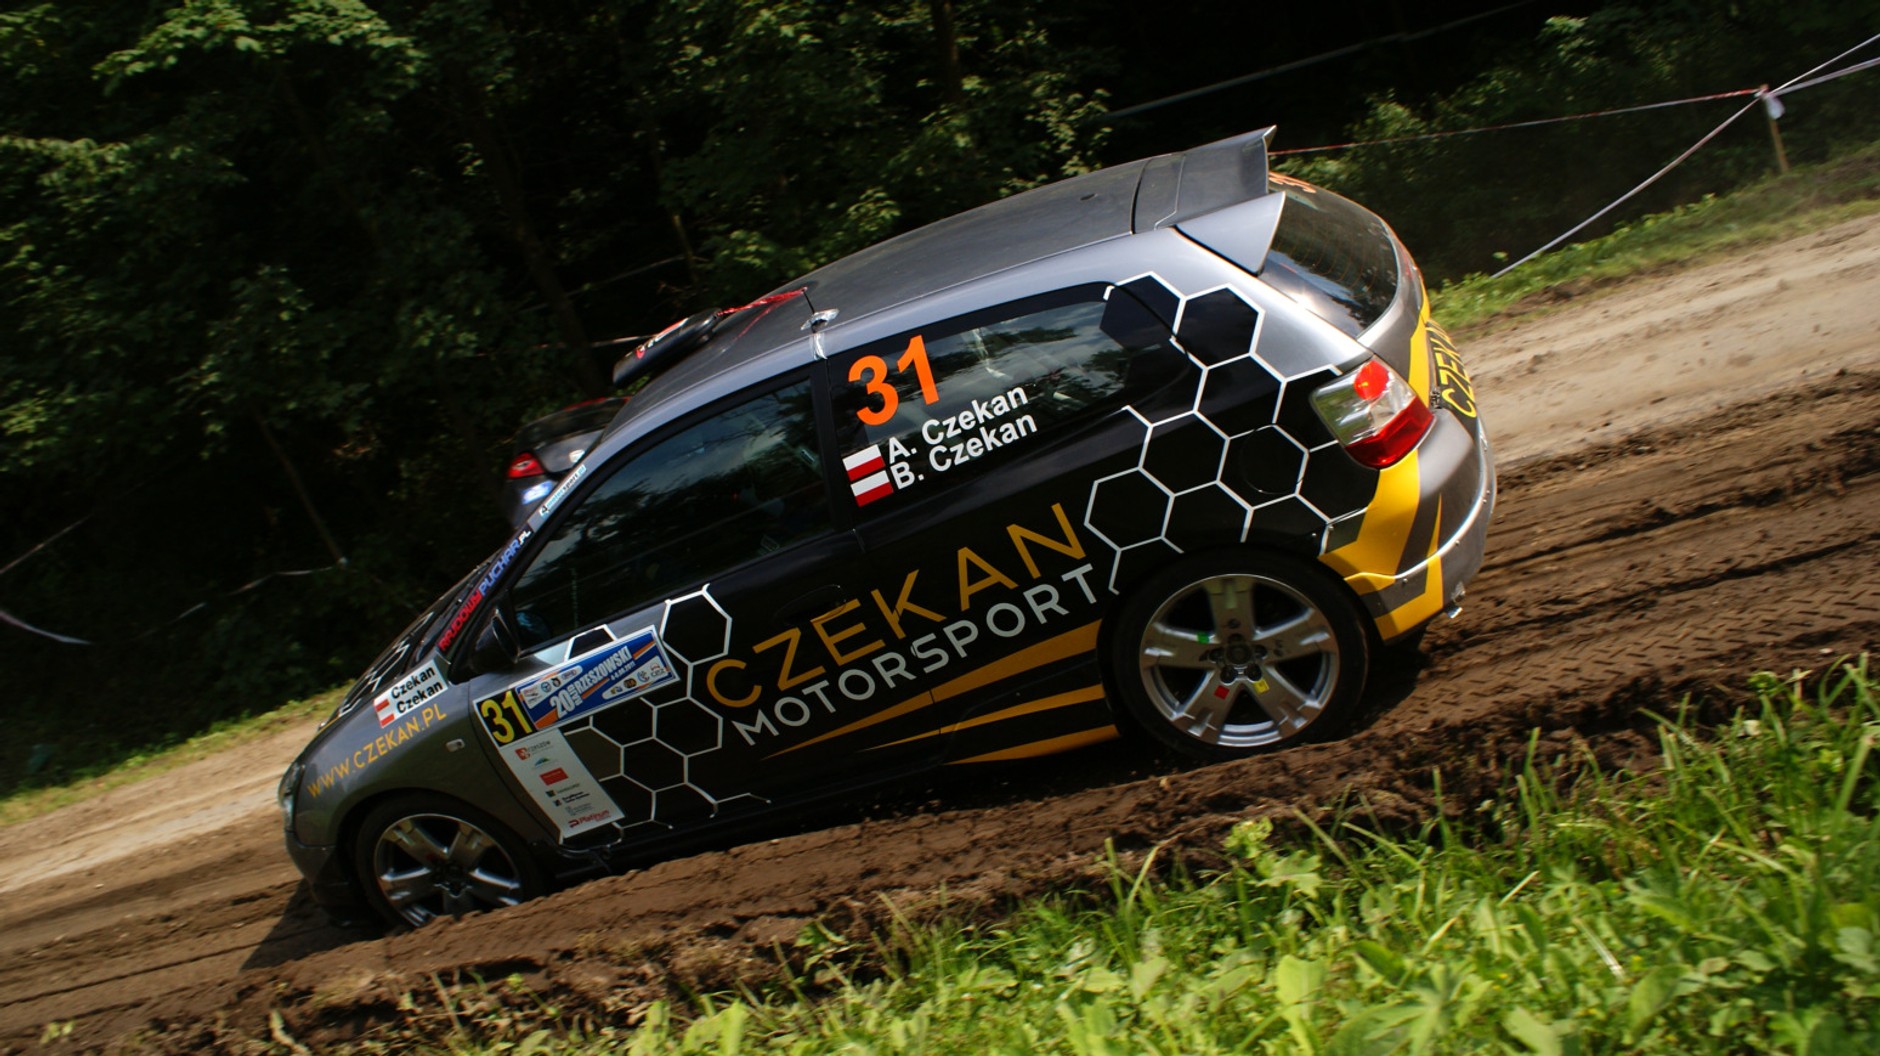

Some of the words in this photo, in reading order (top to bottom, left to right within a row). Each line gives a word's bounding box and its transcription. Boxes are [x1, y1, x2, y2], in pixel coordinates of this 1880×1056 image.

[848, 334, 940, 426] 31
[889, 436, 917, 465] A.
[921, 386, 1029, 446] Czekan
[890, 461, 925, 490] B.
[928, 413, 1038, 472] Czekan
[706, 502, 1087, 708] CZEKAN
[391, 666, 436, 700] Czekan
[549, 688, 576, 719] 20
[573, 645, 633, 694] RZESZOWSKI
[731, 563, 1098, 747] MOTORSPORT
[396, 681, 444, 714] Czekan
[480, 690, 533, 744] 31
[307, 703, 448, 799] WWW.CZEKAN.PL
